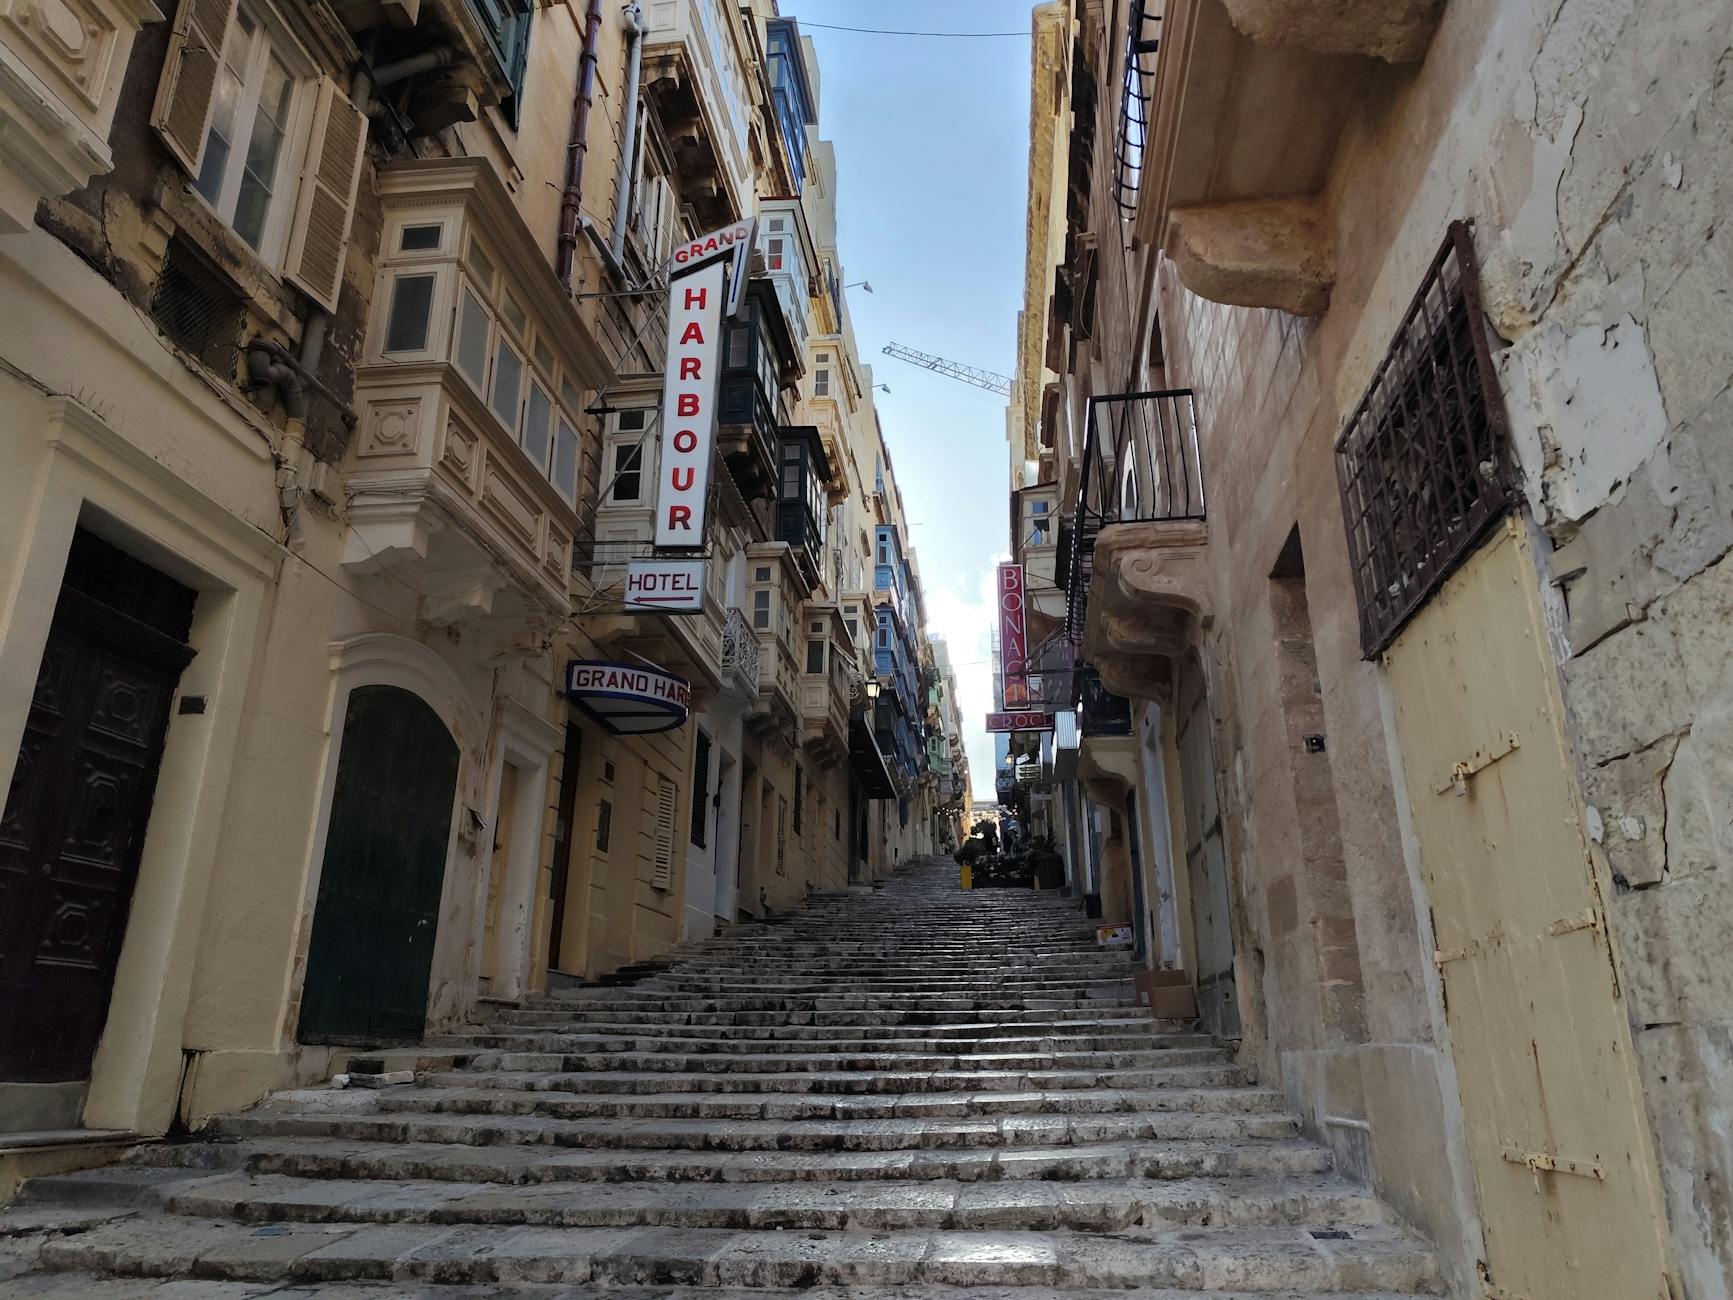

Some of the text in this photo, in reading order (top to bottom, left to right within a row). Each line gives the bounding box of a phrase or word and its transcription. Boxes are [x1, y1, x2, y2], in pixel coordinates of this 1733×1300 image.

[674, 227, 749, 263] GRAND
[668, 288, 707, 531] HARBOUR
[628, 573, 699, 591] HOTEL
[576, 669, 649, 692] GRAND
